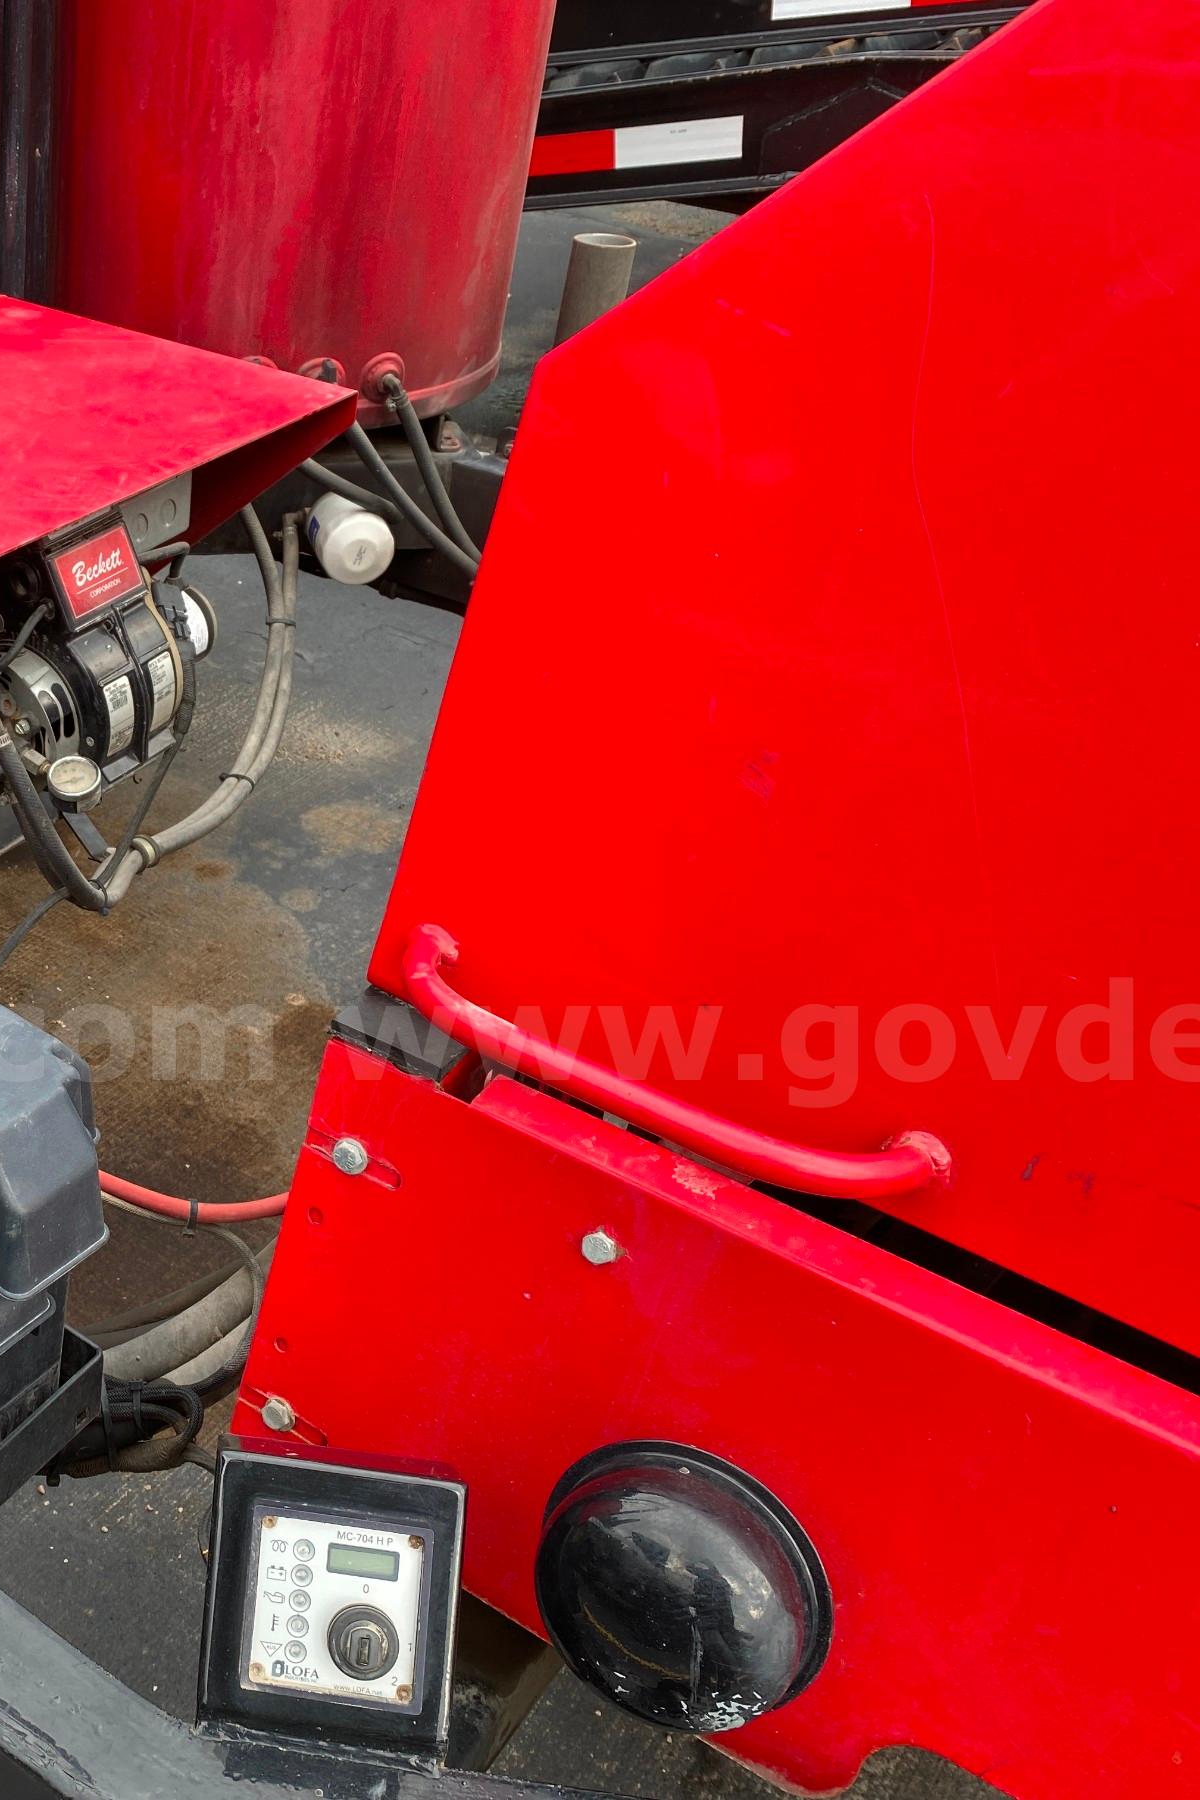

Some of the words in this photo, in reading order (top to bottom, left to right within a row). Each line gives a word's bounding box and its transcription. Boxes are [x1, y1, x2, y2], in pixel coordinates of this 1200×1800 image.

[71, 547, 122, 587] Beckett
[337, 1530, 373, 1544] MC-704
[285, 1664, 319, 1680] LOFA
[391, 1676, 398, 1686] 2
